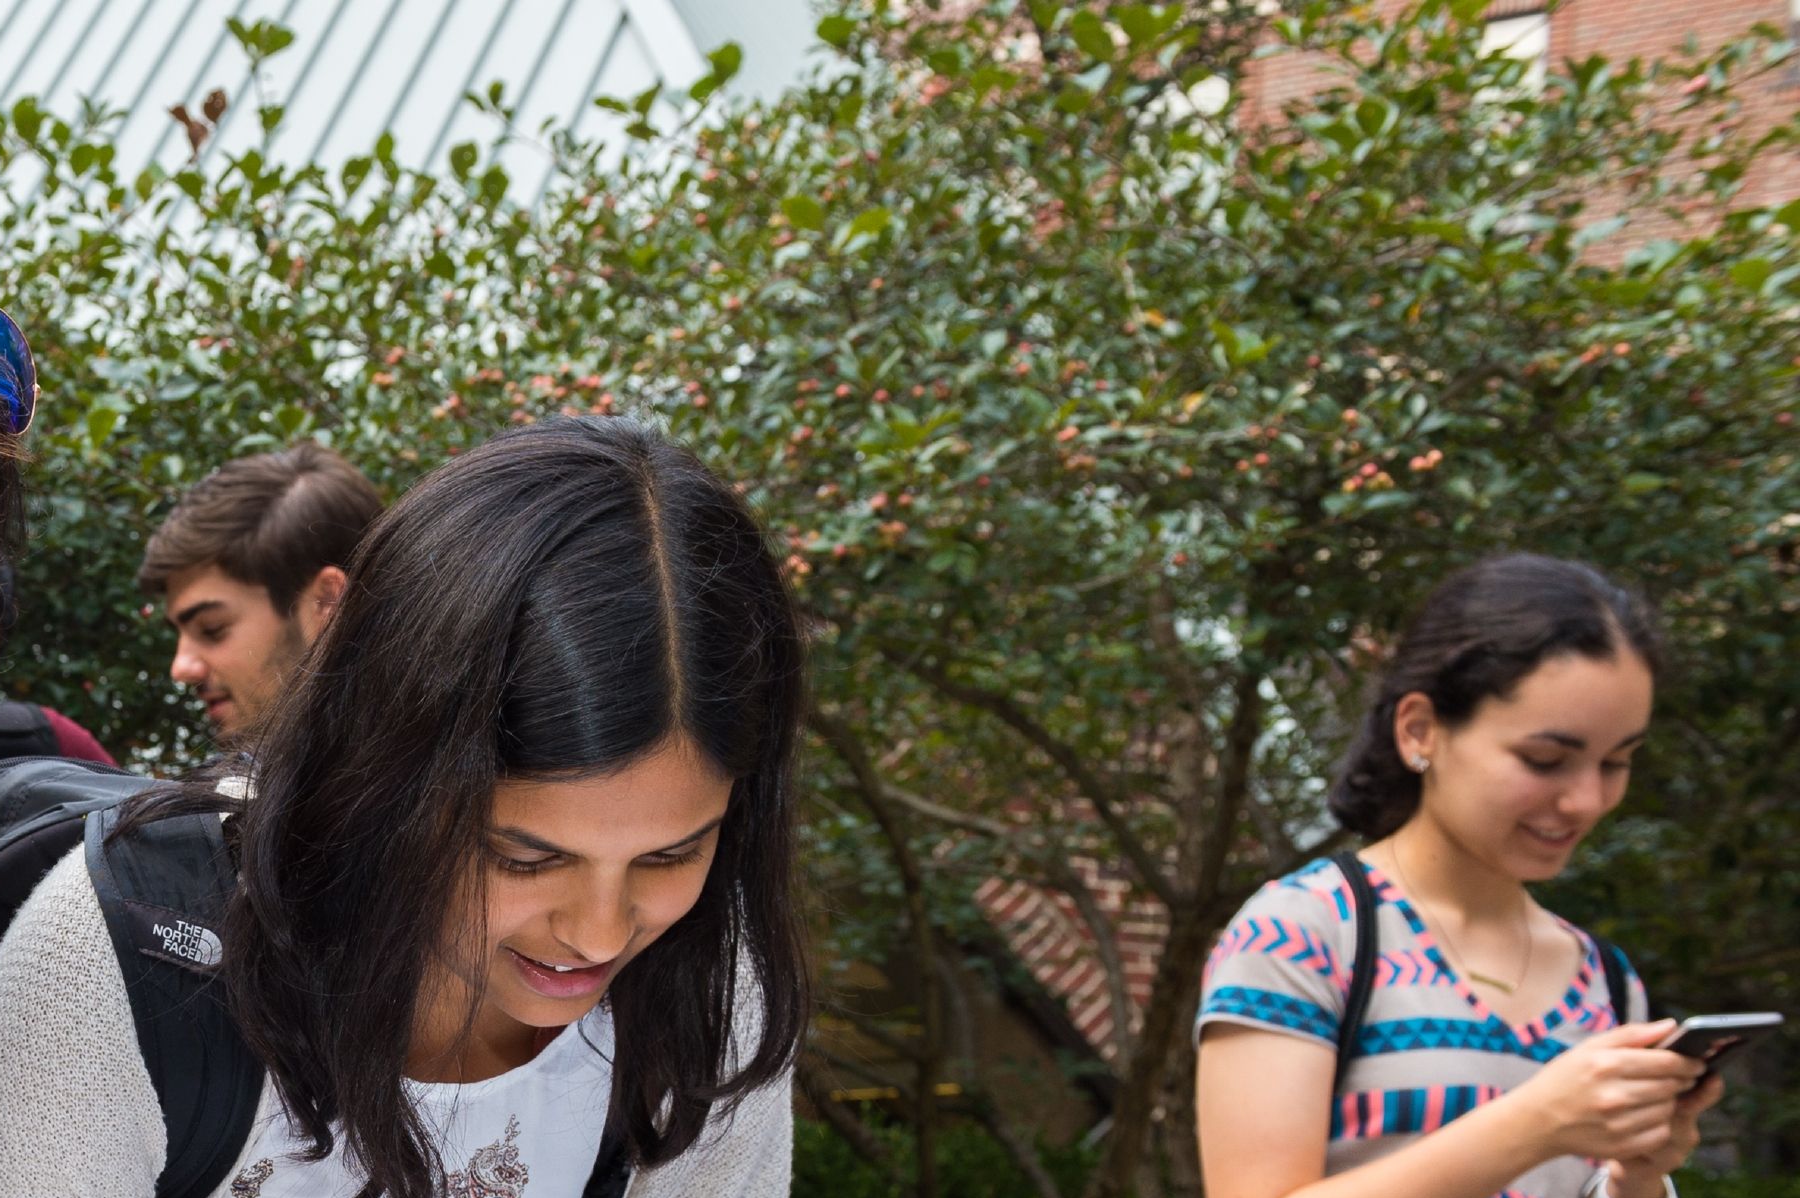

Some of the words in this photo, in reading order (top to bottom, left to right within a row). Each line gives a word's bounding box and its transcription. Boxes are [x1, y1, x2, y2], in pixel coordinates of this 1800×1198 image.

[152, 923, 200, 949] NORTH
[176, 920, 203, 938] THE
[162, 939, 196, 960] FACE
